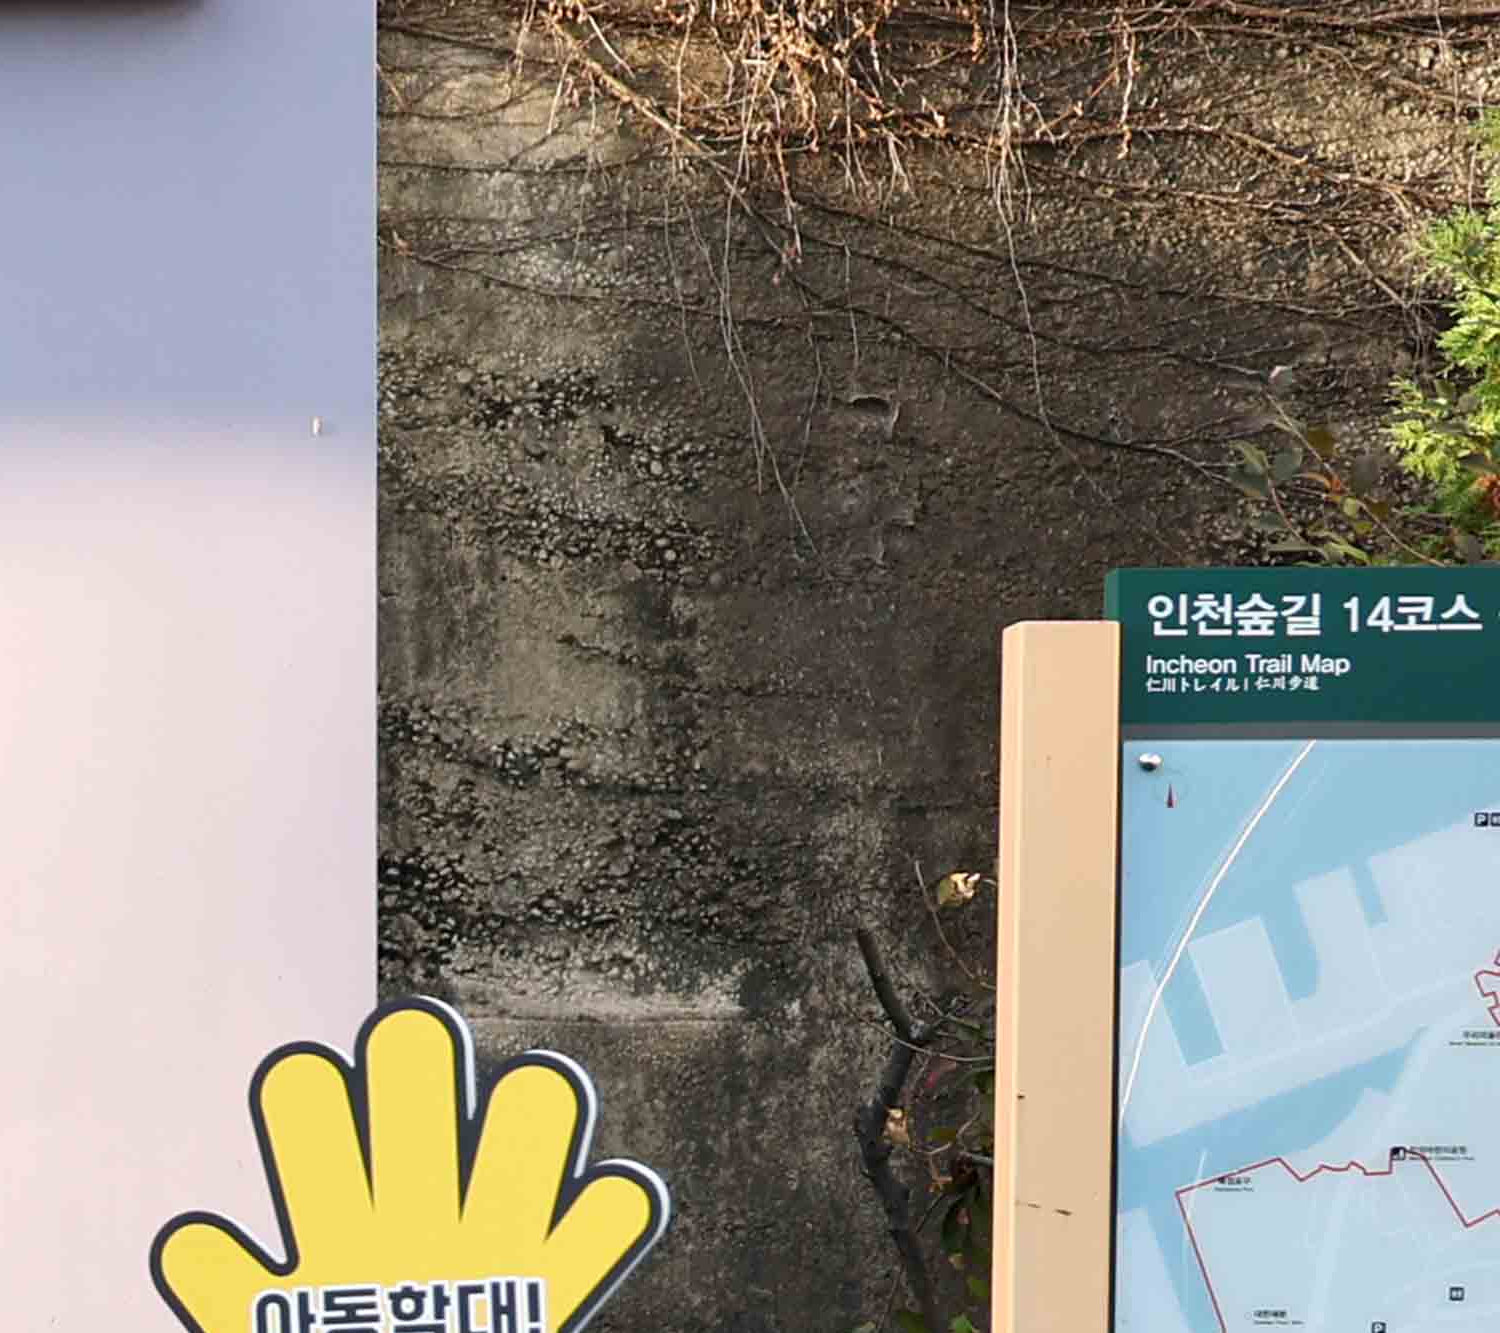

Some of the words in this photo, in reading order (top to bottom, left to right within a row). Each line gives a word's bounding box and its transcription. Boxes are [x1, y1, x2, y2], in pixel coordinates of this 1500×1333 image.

[1147, 592, 1322, 637] 인천숲길
[1342, 593, 1484, 633] 14코스
[1146, 653, 1238, 675] Incheon
[1244, 653, 1293, 674] Trail
[1300, 653, 1350, 677] Map
